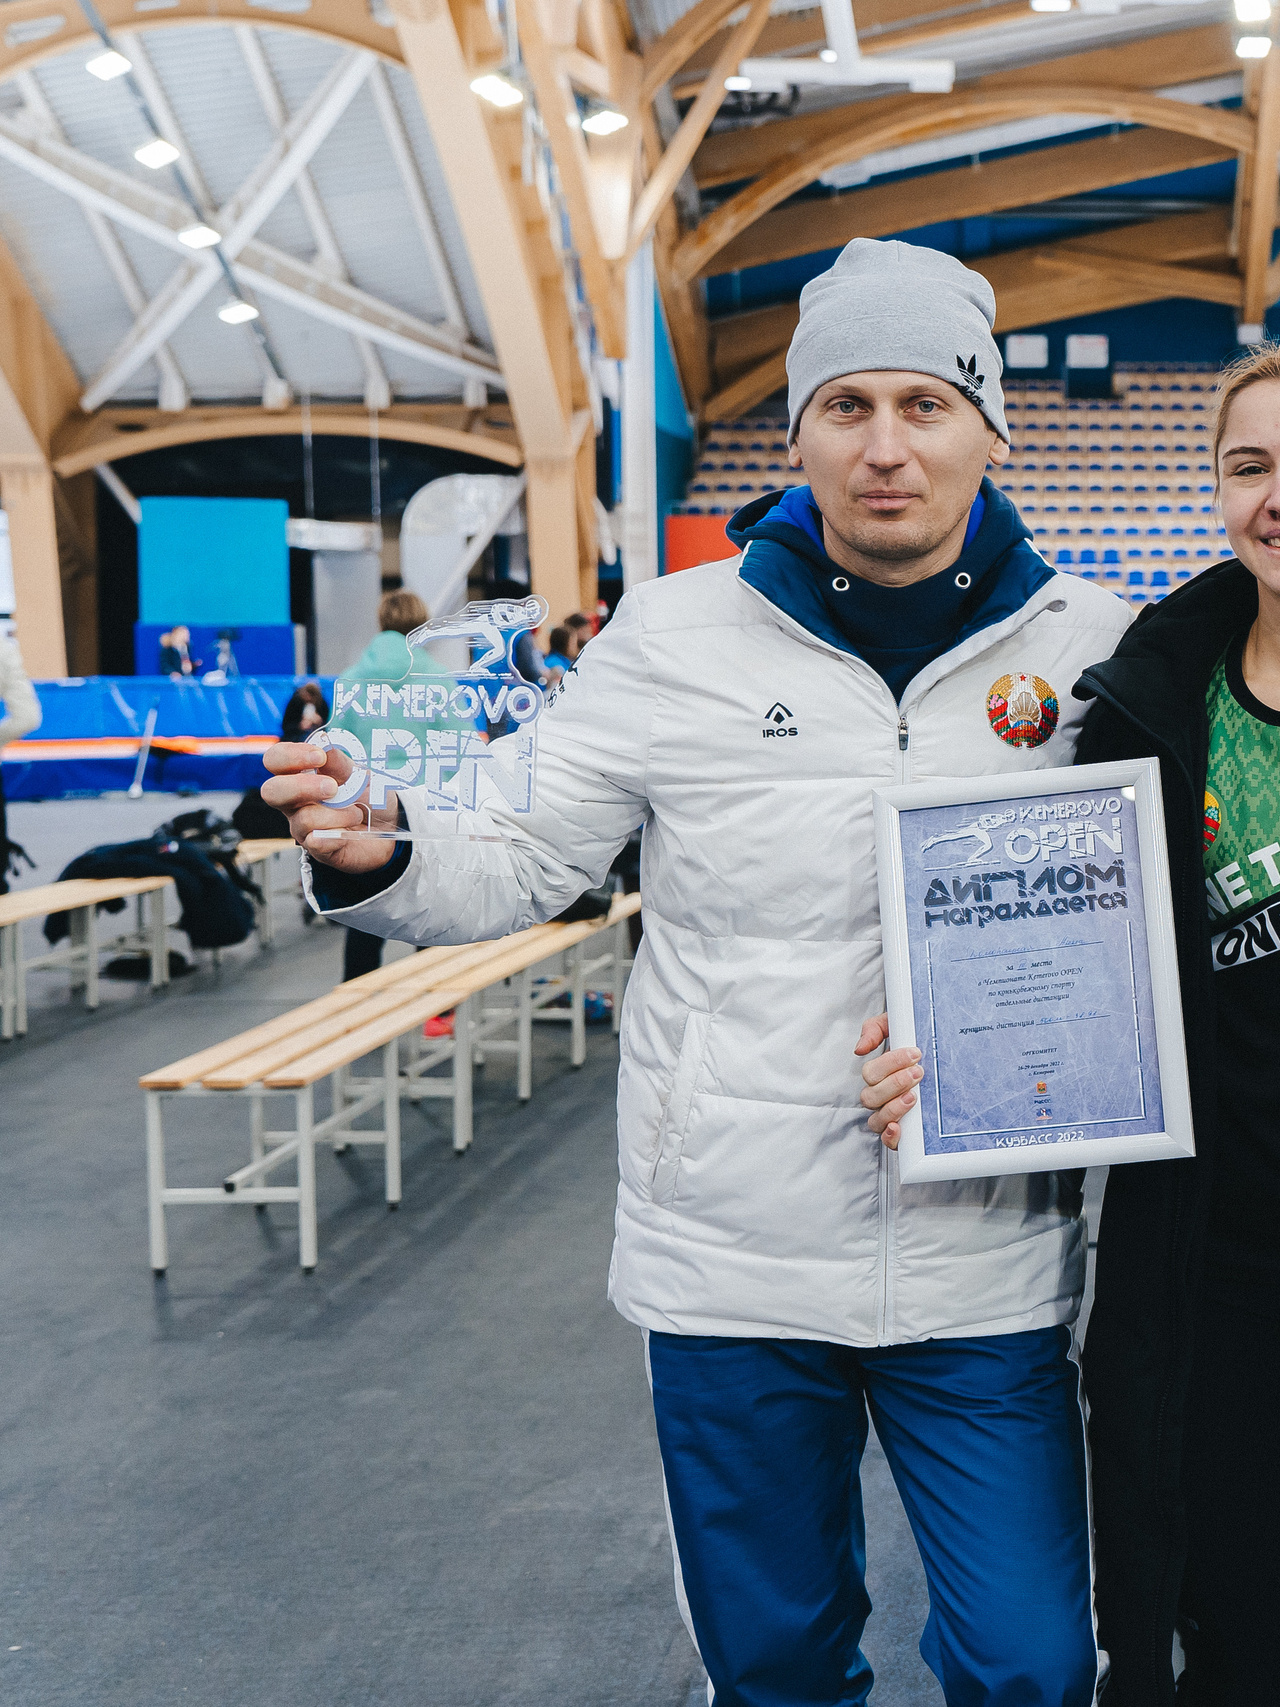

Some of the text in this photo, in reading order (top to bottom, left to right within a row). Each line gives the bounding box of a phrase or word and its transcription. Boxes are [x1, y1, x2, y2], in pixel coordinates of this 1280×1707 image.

[335, 683, 539, 723] KEMEROVO
[762, 727, 798, 738] IROS
[304, 728, 536, 814] OPEN
[1019, 797, 1122, 822] KEMEROVO
[1005, 817, 1123, 864] OPEN
[924, 859, 1126, 908] ДИПЛОМ
[1205, 861, 1253, 921] NE
[1060, 967, 1084, 976] OPEN
[996, 1131, 1085, 1148] КУЗБАСС 2022
